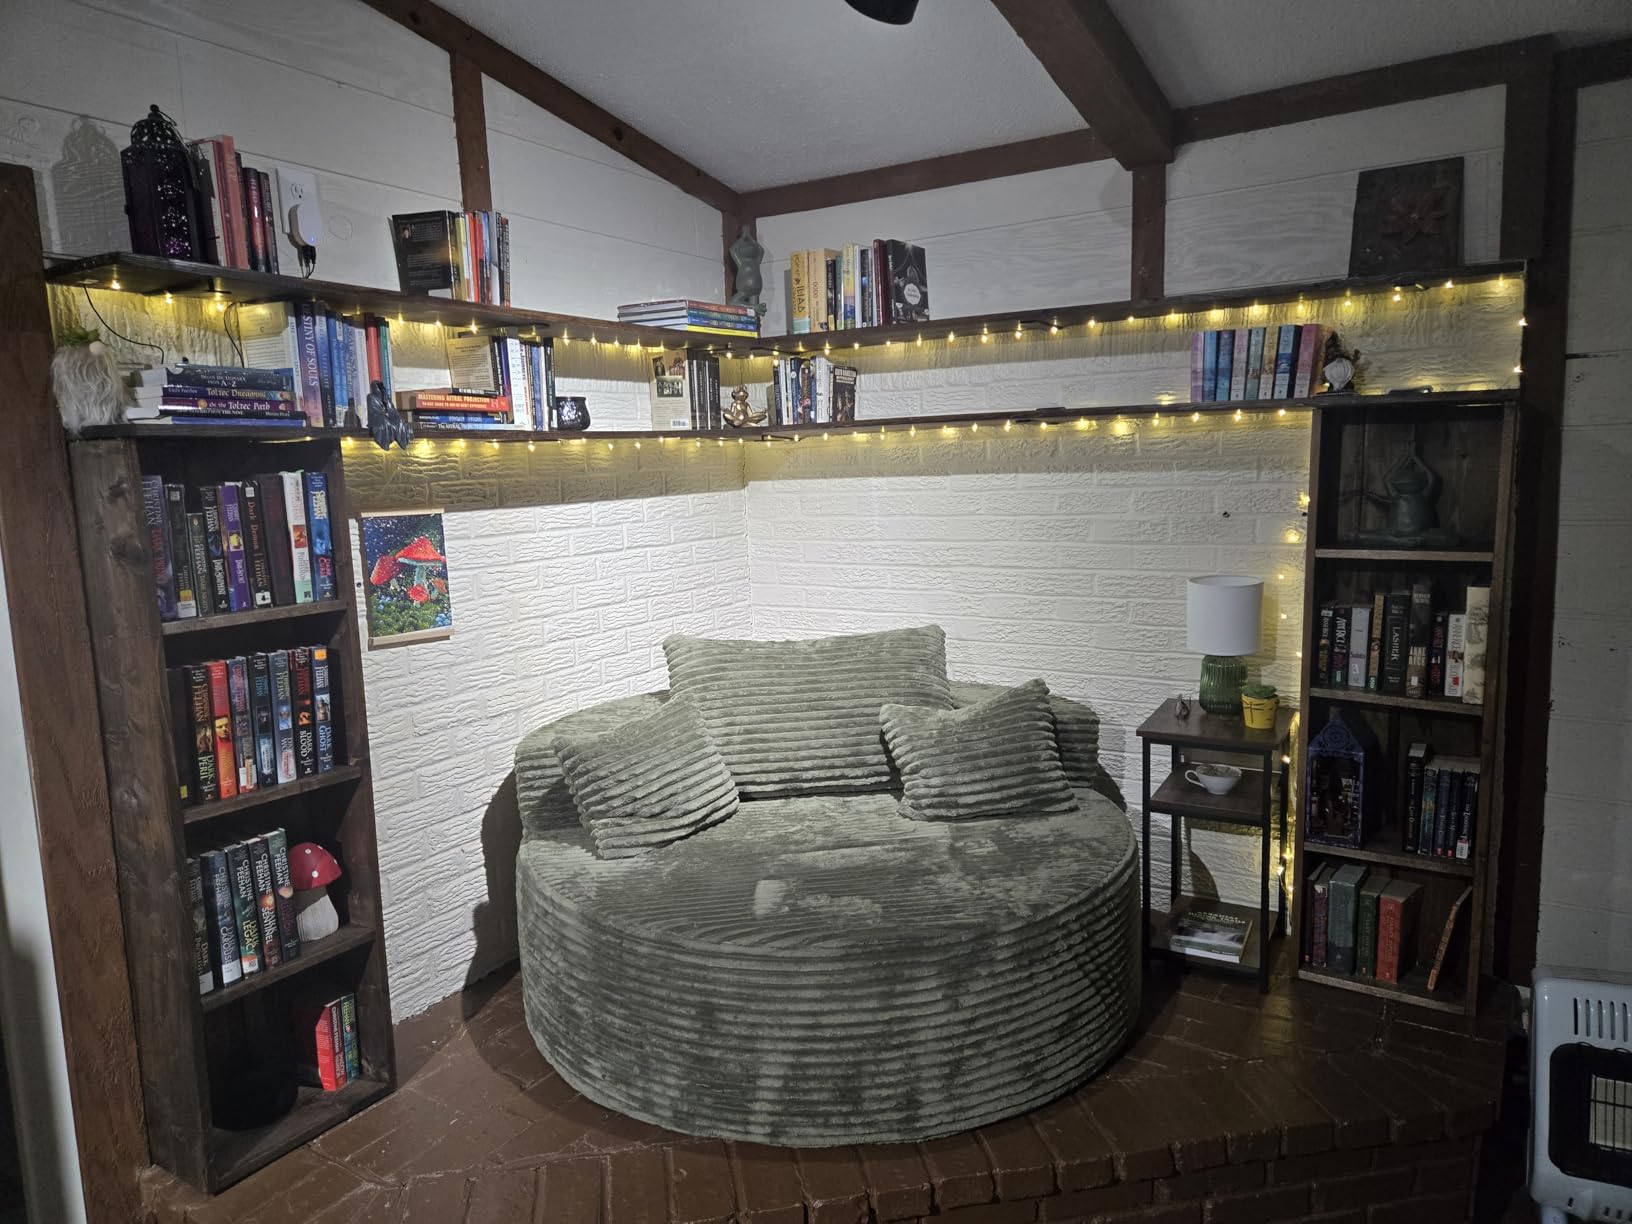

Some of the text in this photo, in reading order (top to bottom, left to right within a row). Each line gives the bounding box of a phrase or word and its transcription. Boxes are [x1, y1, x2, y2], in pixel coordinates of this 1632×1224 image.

[305, 343, 317, 357] OF
[306, 357, 319, 387] SOULS
[227, 400, 252, 410] Toltec
[253, 401, 270, 411] Path
[299, 730, 309, 758] BLOOD
[306, 731, 314, 754] DARK
[318, 725, 328, 752] GHOST
[325, 726, 333, 750] DARK
[197, 755, 208, 780] PERIL
[206, 753, 216, 781] DARK
[242, 859, 254, 902] CHRISTINE
[255, 859, 266, 892] FEEHAN
[261, 853, 273, 894] CHRISTINE
[273, 852, 285, 885] FEEHAN
[280, 846, 292, 888] CHRISTINE
[218, 866, 230, 909] CHRISTINE
[236, 866, 248, 899] FEEHAN
[250, 919, 260, 948] DARK
[261, 906, 273, 945] SENTINEL
[268, 906, 278, 934] DARK
[242, 919, 255, 957] LEGACY
